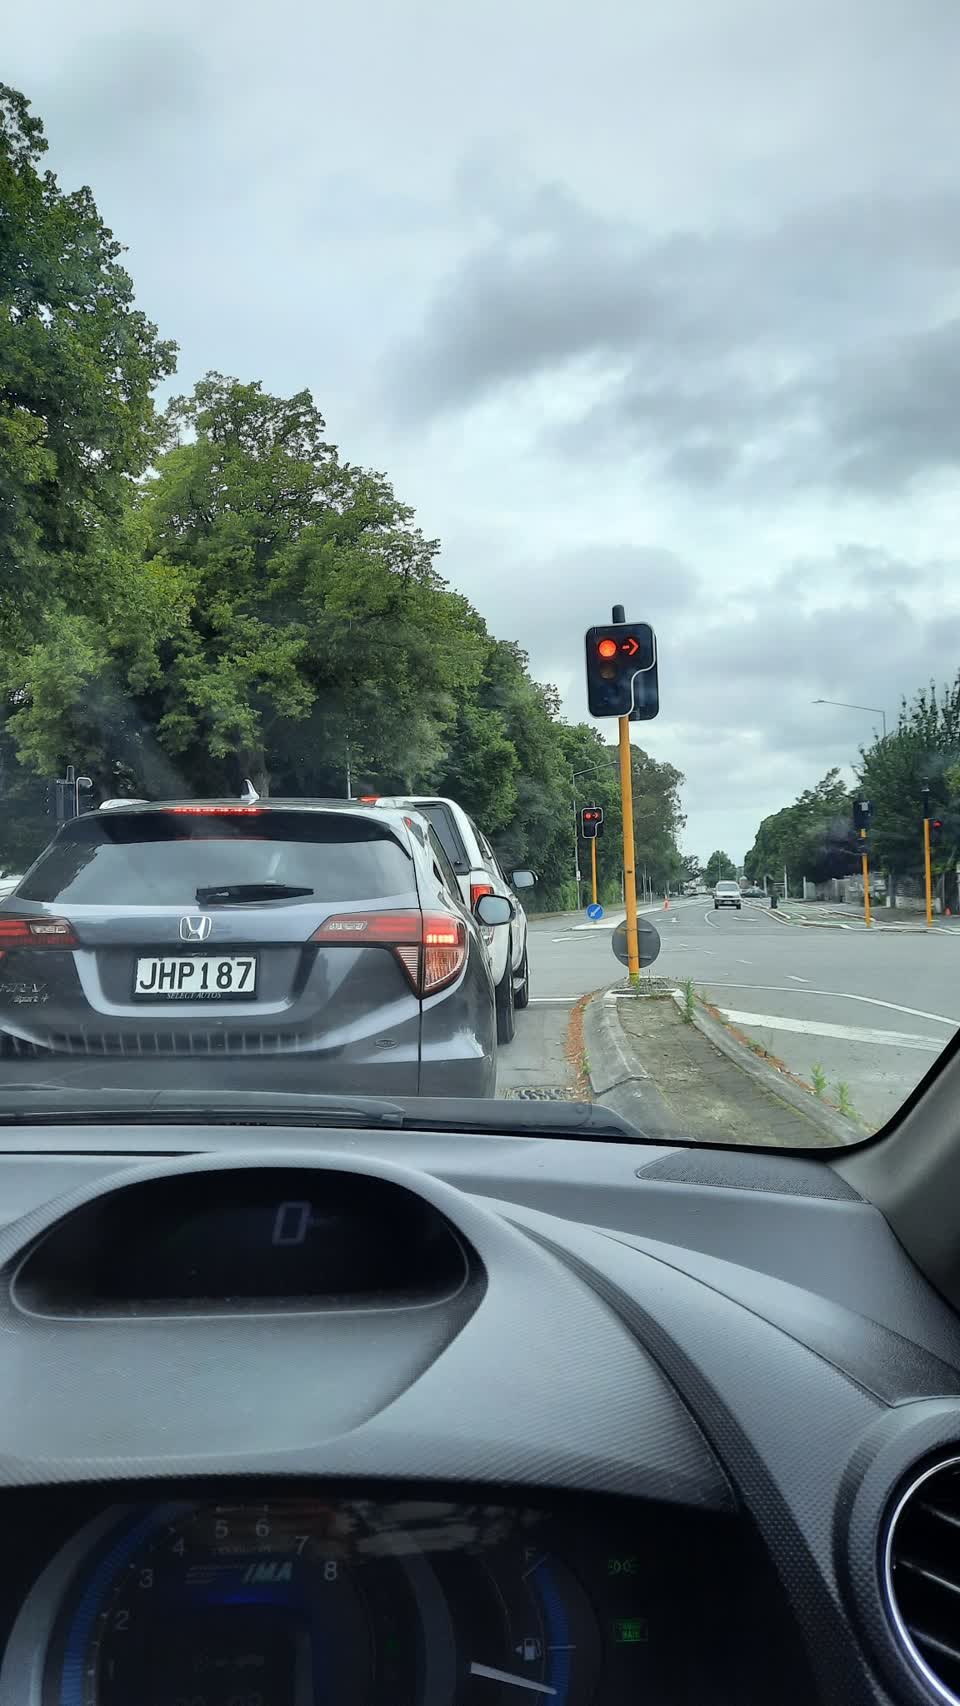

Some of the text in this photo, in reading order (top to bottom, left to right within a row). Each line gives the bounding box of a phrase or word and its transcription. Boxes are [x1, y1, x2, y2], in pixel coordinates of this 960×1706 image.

[139, 961, 252, 990] JHP187
[271, 1201, 312, 1246] 0
[215, 1519, 229, 1539] 5
[255, 1518, 270, 1538] 6
[172, 1537, 185, 1557] 4
[295, 1535, 310, 1555] 7
[138, 1568, 153, 1588] 3
[323, 1560, 338, 1581] 8
[114, 1610, 129, 1630] 2
